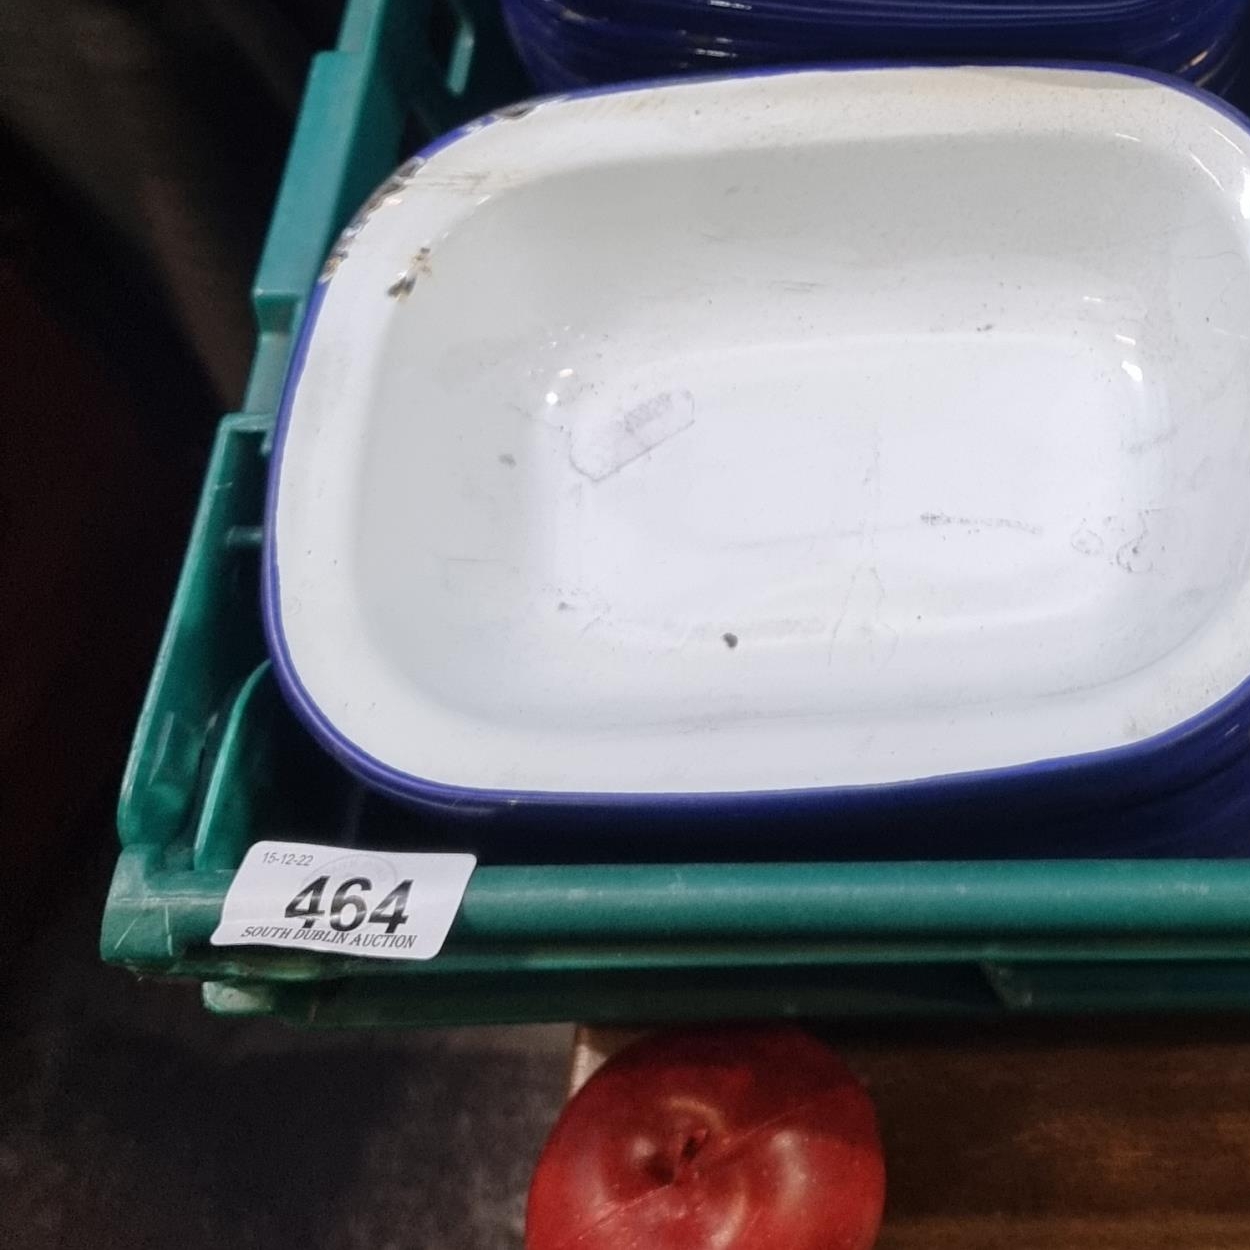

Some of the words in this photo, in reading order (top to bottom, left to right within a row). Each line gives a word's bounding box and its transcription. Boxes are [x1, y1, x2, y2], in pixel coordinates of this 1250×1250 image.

[263, 852, 314, 867] 15-12-22
[285, 876, 414, 934] 464
[240, 926, 296, 940] SOUTH
[294, 928, 349, 944] DUBLIN
[350, 932, 418, 949] AUCTION
